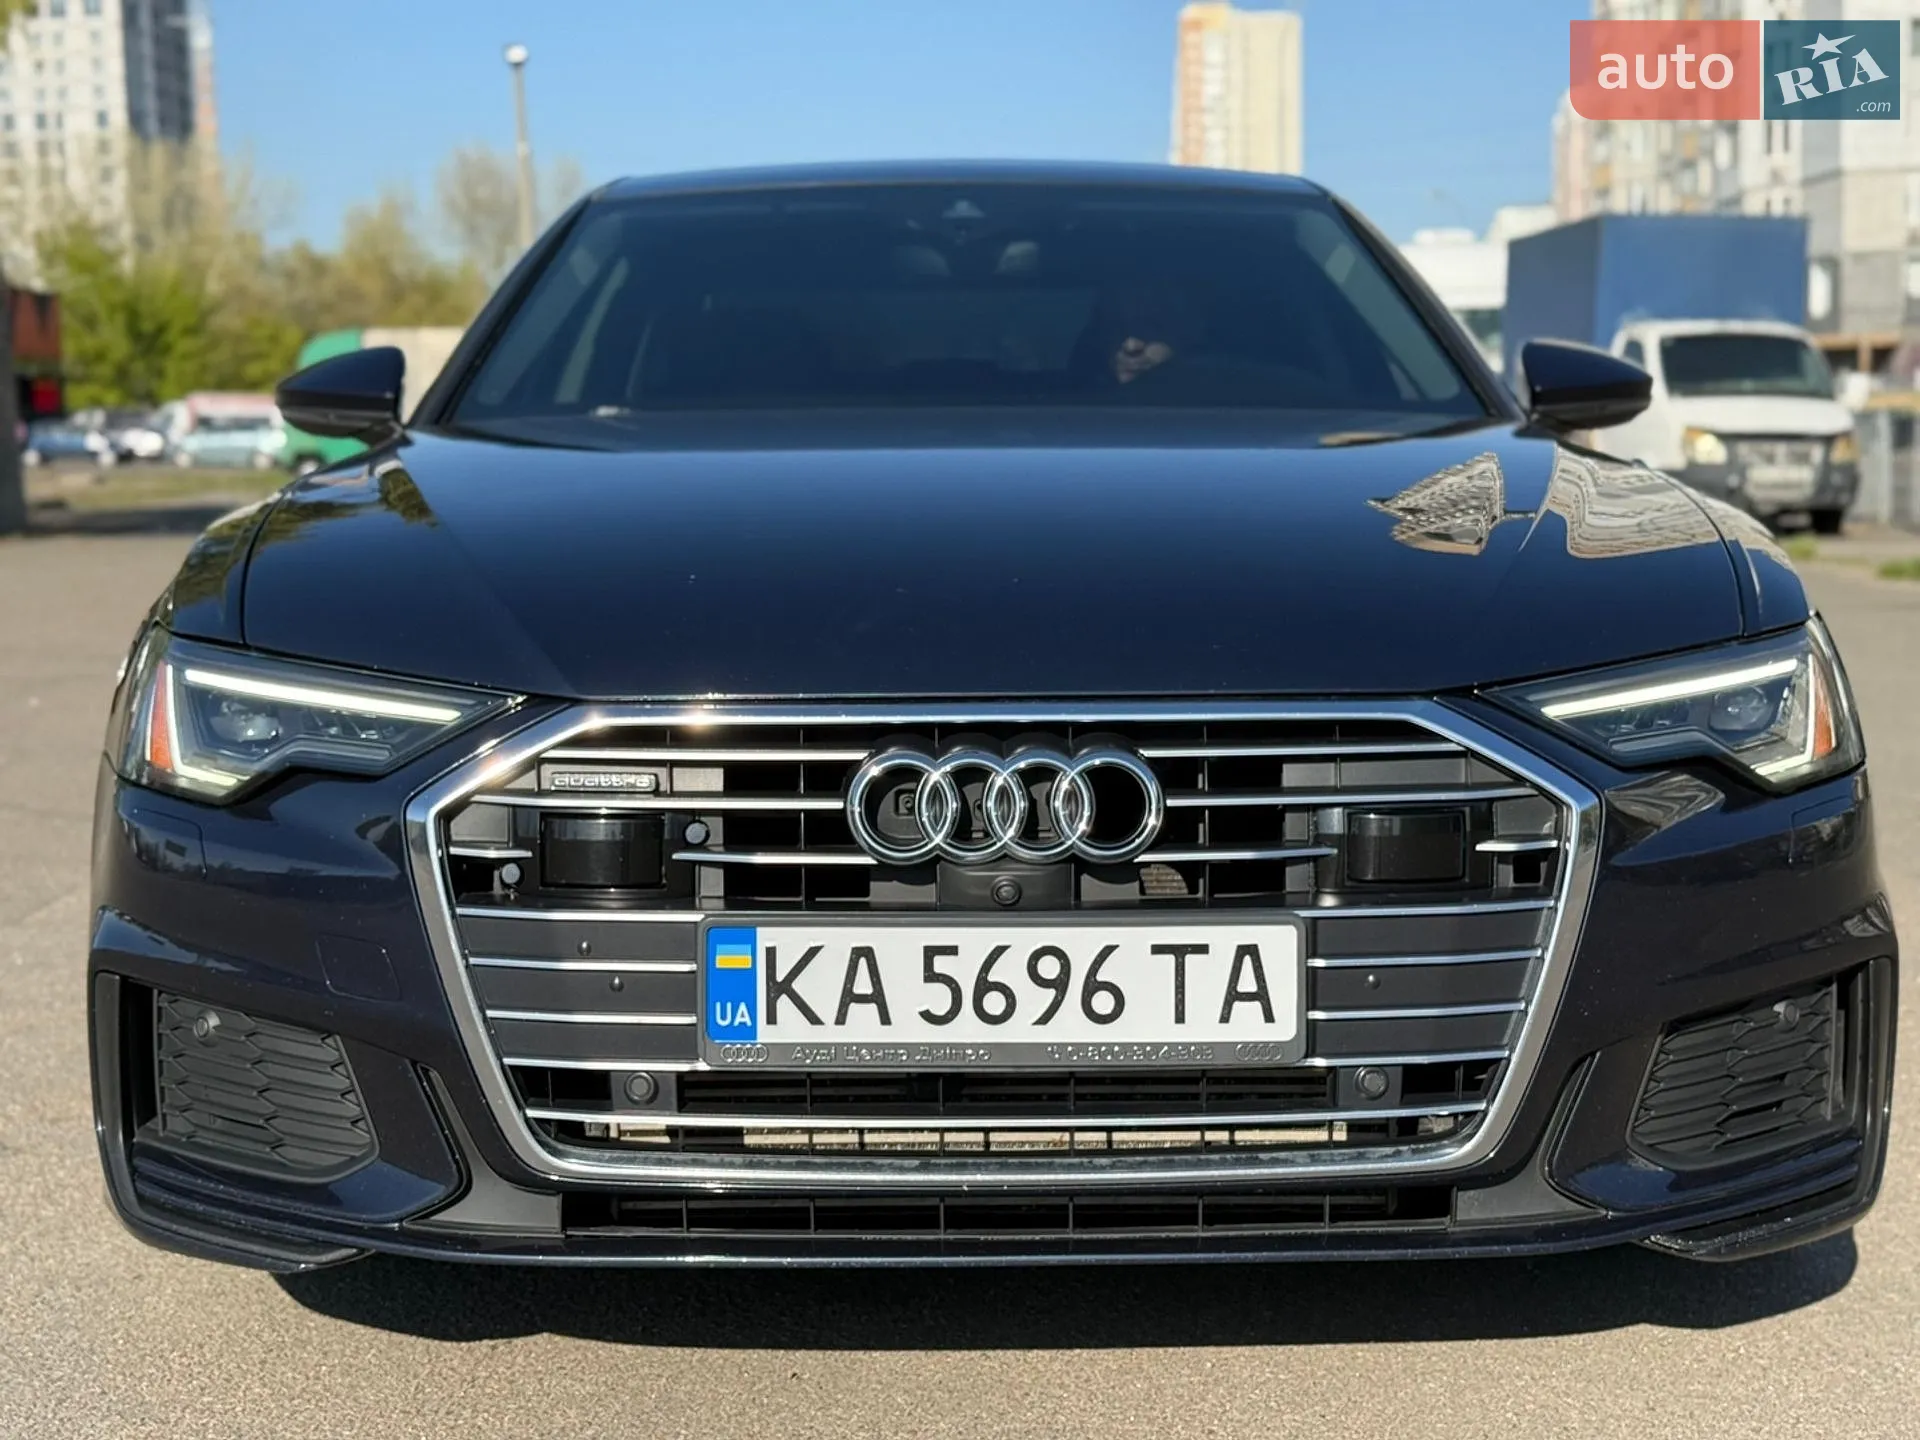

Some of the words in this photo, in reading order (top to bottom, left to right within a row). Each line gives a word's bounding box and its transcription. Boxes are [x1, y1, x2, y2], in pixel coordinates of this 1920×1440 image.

[553, 773, 651, 788] quattro
[765, 945, 892, 1026] KA
[918, 945, 1126, 1026] 5696
[1150, 944, 1276, 1025] TA
[715, 1002, 752, 1026] UA
[843, 1046, 909, 1062] Центр
